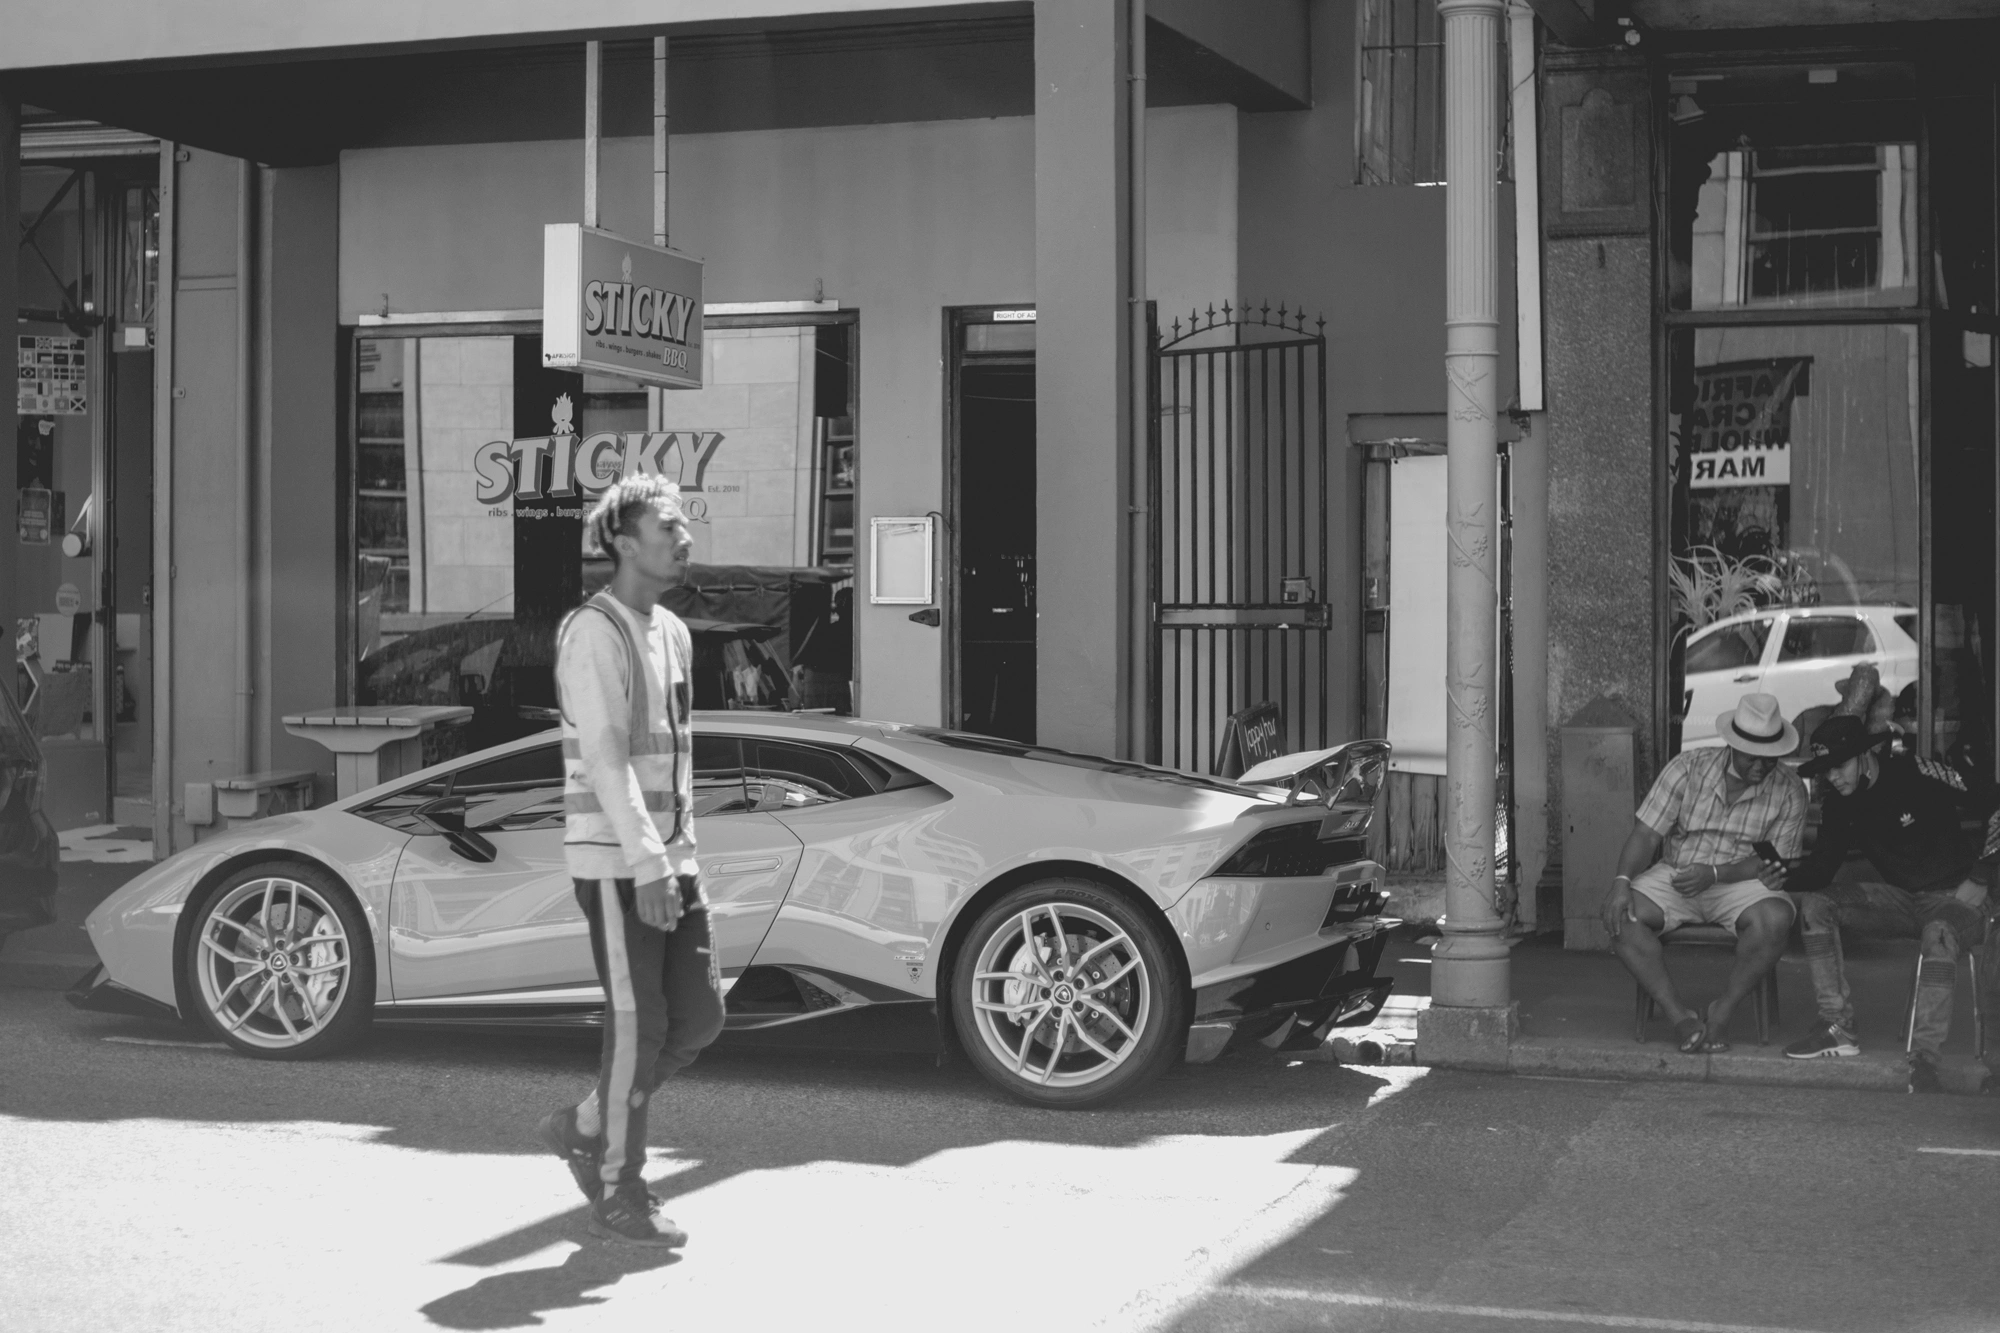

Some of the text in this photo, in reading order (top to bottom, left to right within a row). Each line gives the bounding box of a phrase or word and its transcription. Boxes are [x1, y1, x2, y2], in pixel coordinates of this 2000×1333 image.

[585, 280, 695, 346] STICKY
[595, 340, 661, 360] ribs wings burgers shakes
[663, 346, 688, 373] BBQ
[474, 431, 726, 505] STICKY
[708, 485, 740, 493] Est. 2010
[488, 507, 508, 517] ribs
[515, 506, 548, 520] wings
[1055, 889, 1116, 910] PROXES
